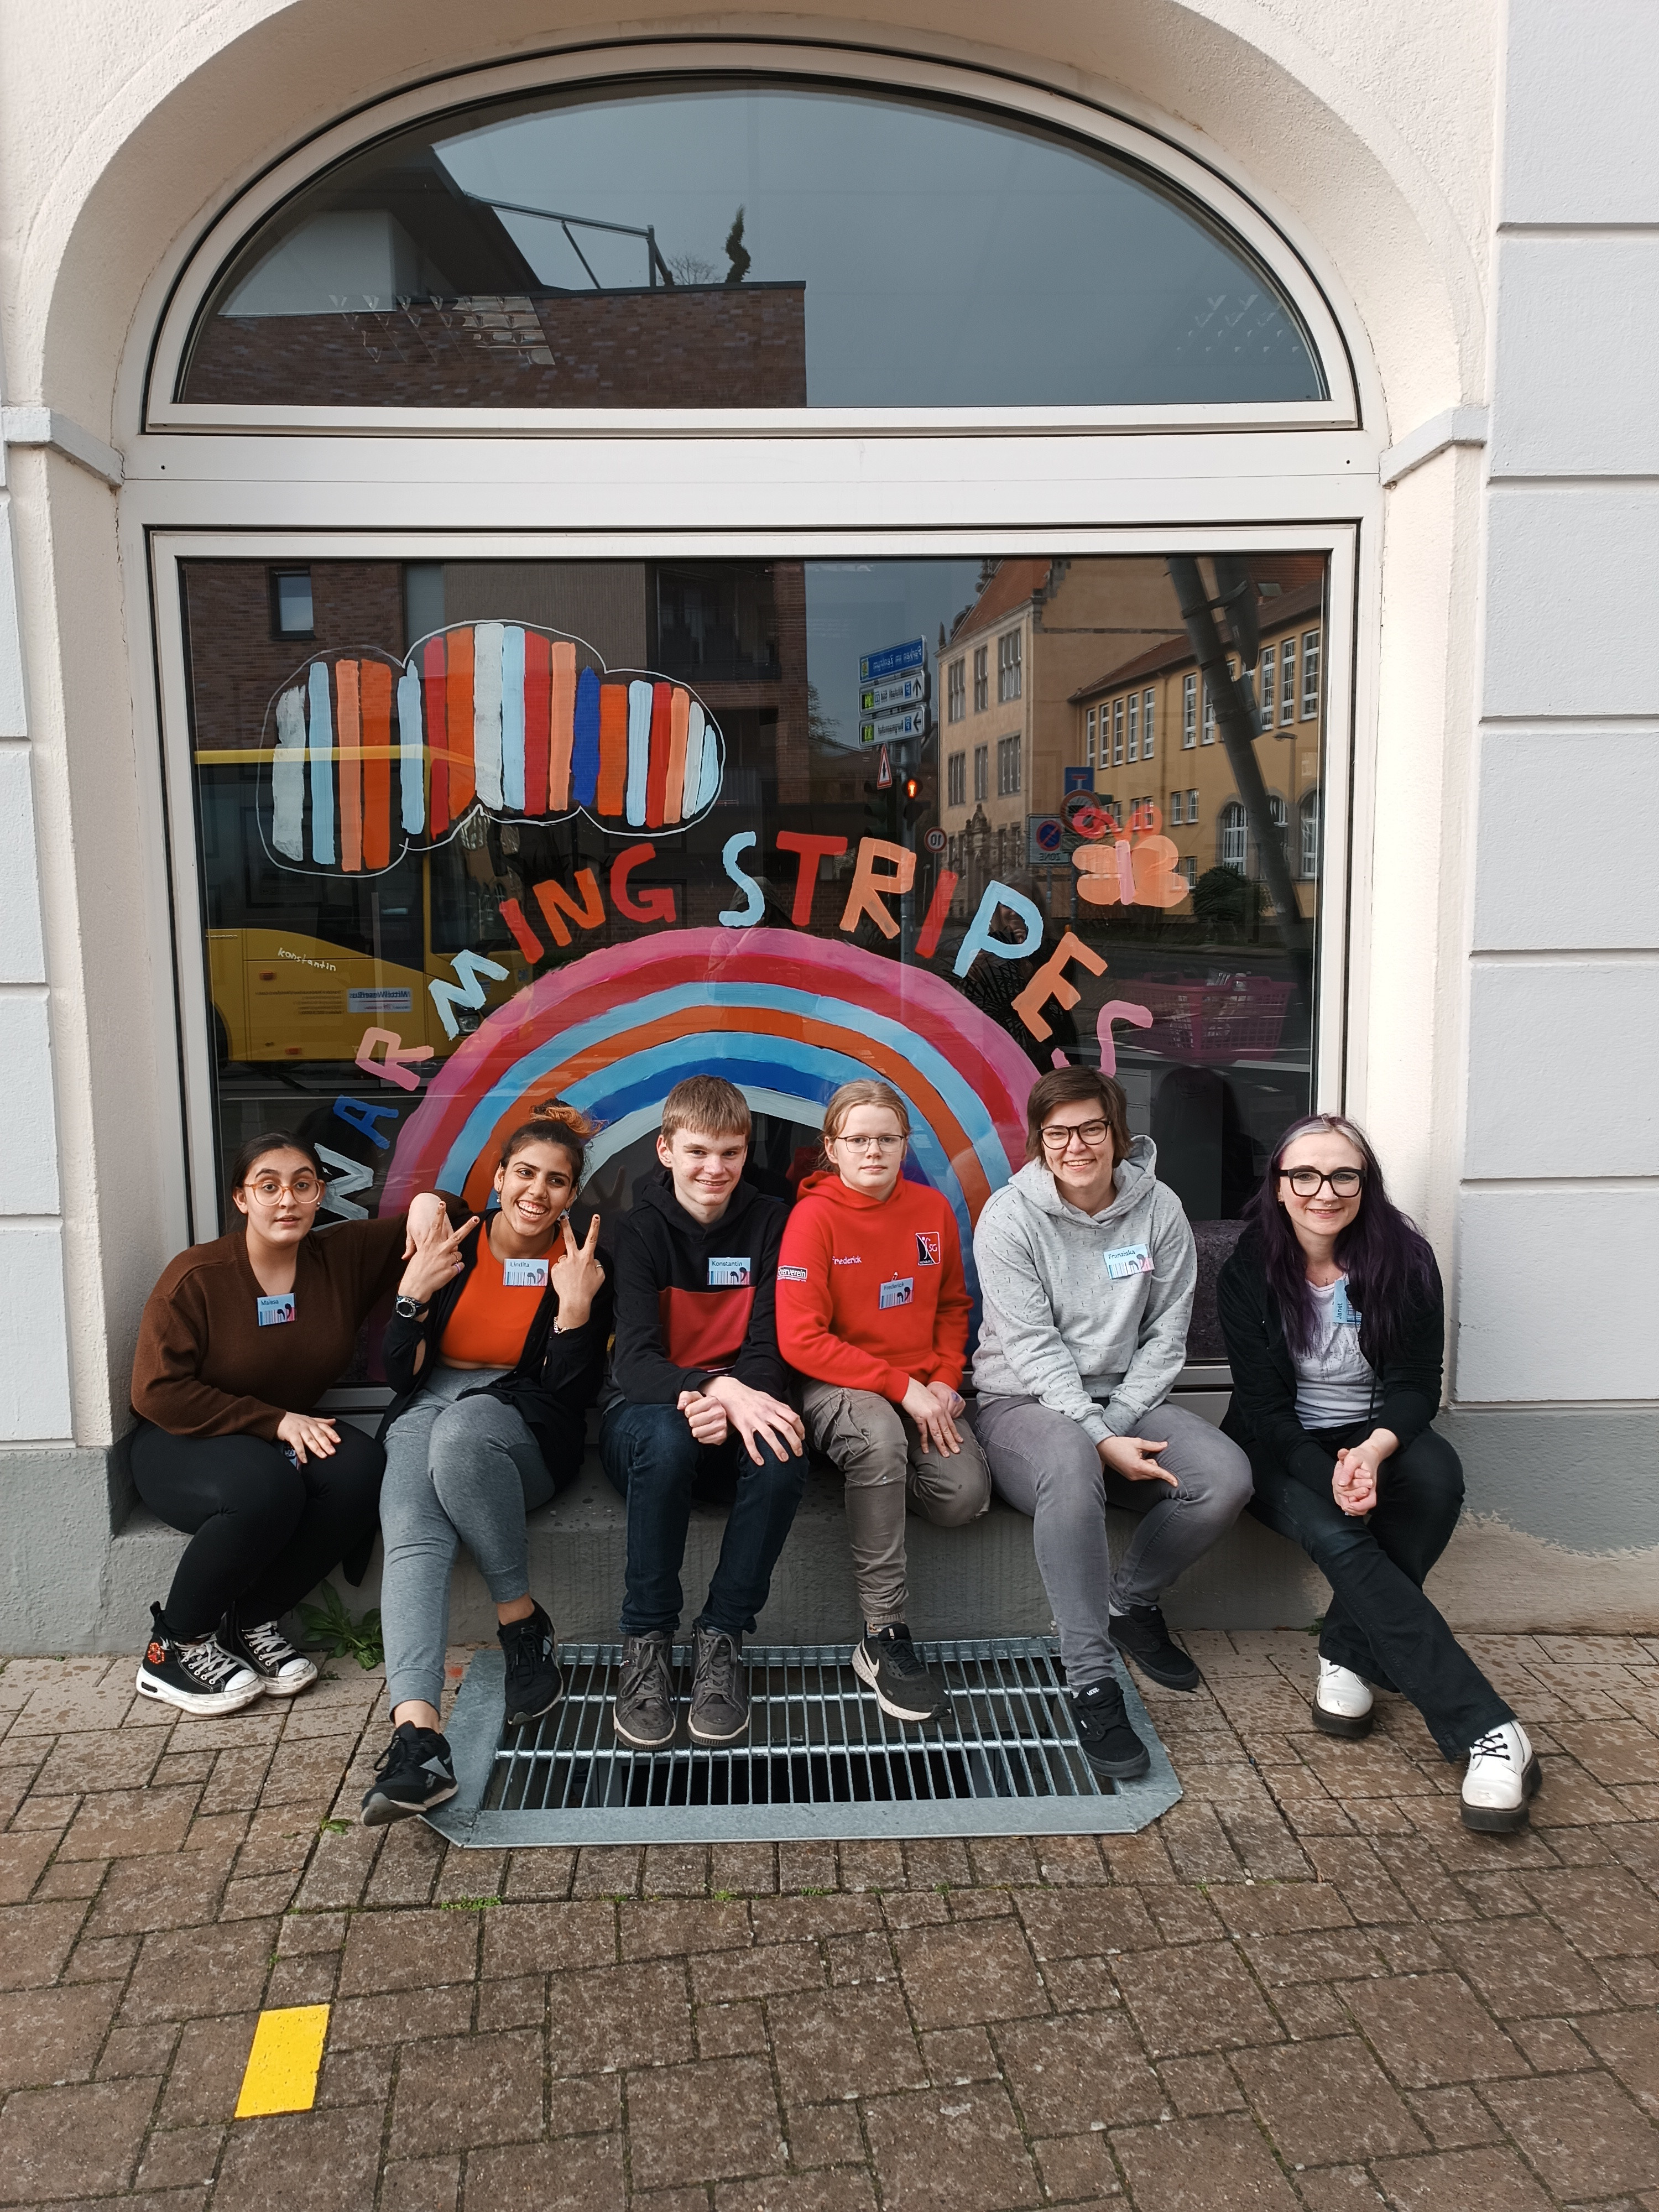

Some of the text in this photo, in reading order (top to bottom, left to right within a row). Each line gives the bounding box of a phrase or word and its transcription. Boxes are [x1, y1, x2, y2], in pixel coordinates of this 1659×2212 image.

[311, 842, 676, 1232] WARMING
[929, 1244, 938, 1252] SG
[884, 1281, 904, 1291] Frederick
